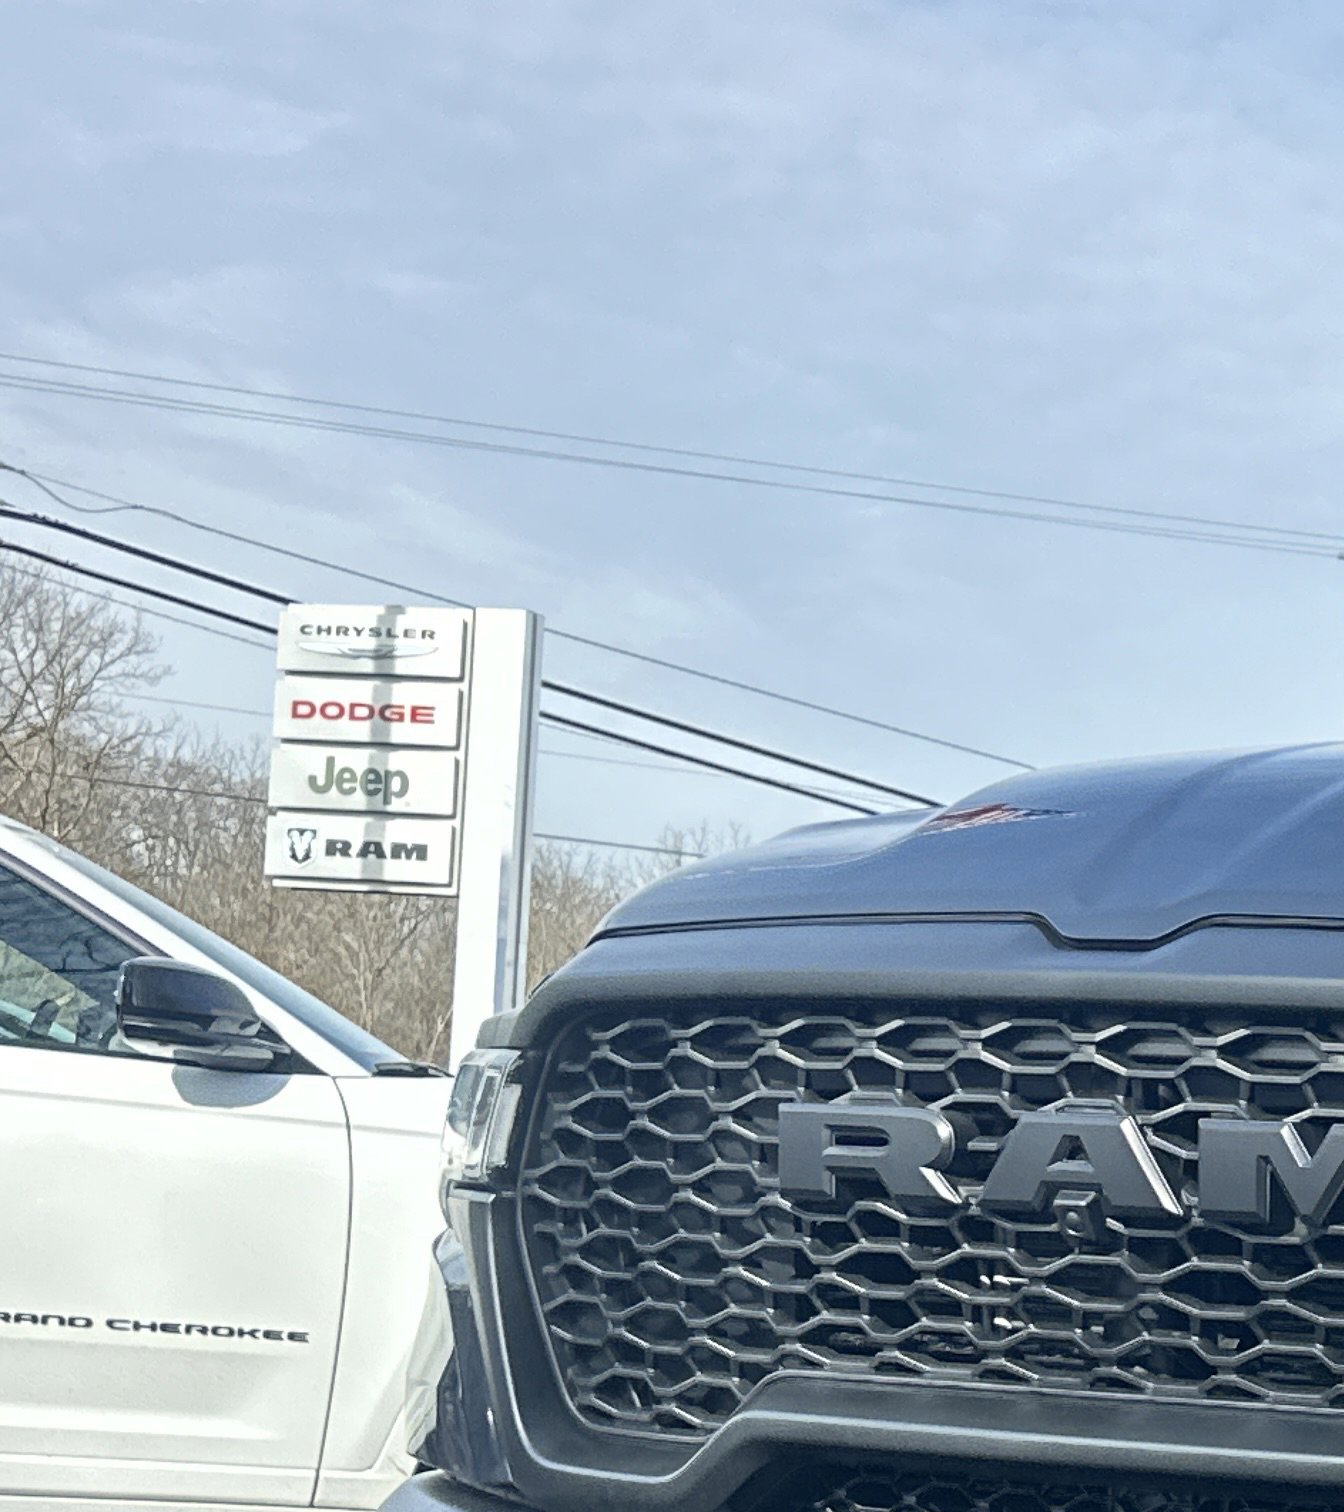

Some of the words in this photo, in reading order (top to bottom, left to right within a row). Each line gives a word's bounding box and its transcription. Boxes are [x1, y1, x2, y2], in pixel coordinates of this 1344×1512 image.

[299, 624, 437, 640] CHRYSLER
[291, 700, 436, 724] DODGE
[308, 755, 410, 806] Jeep
[324, 839, 429, 862] RAM
[106, 1318, 309, 1343] CHEROKEE
